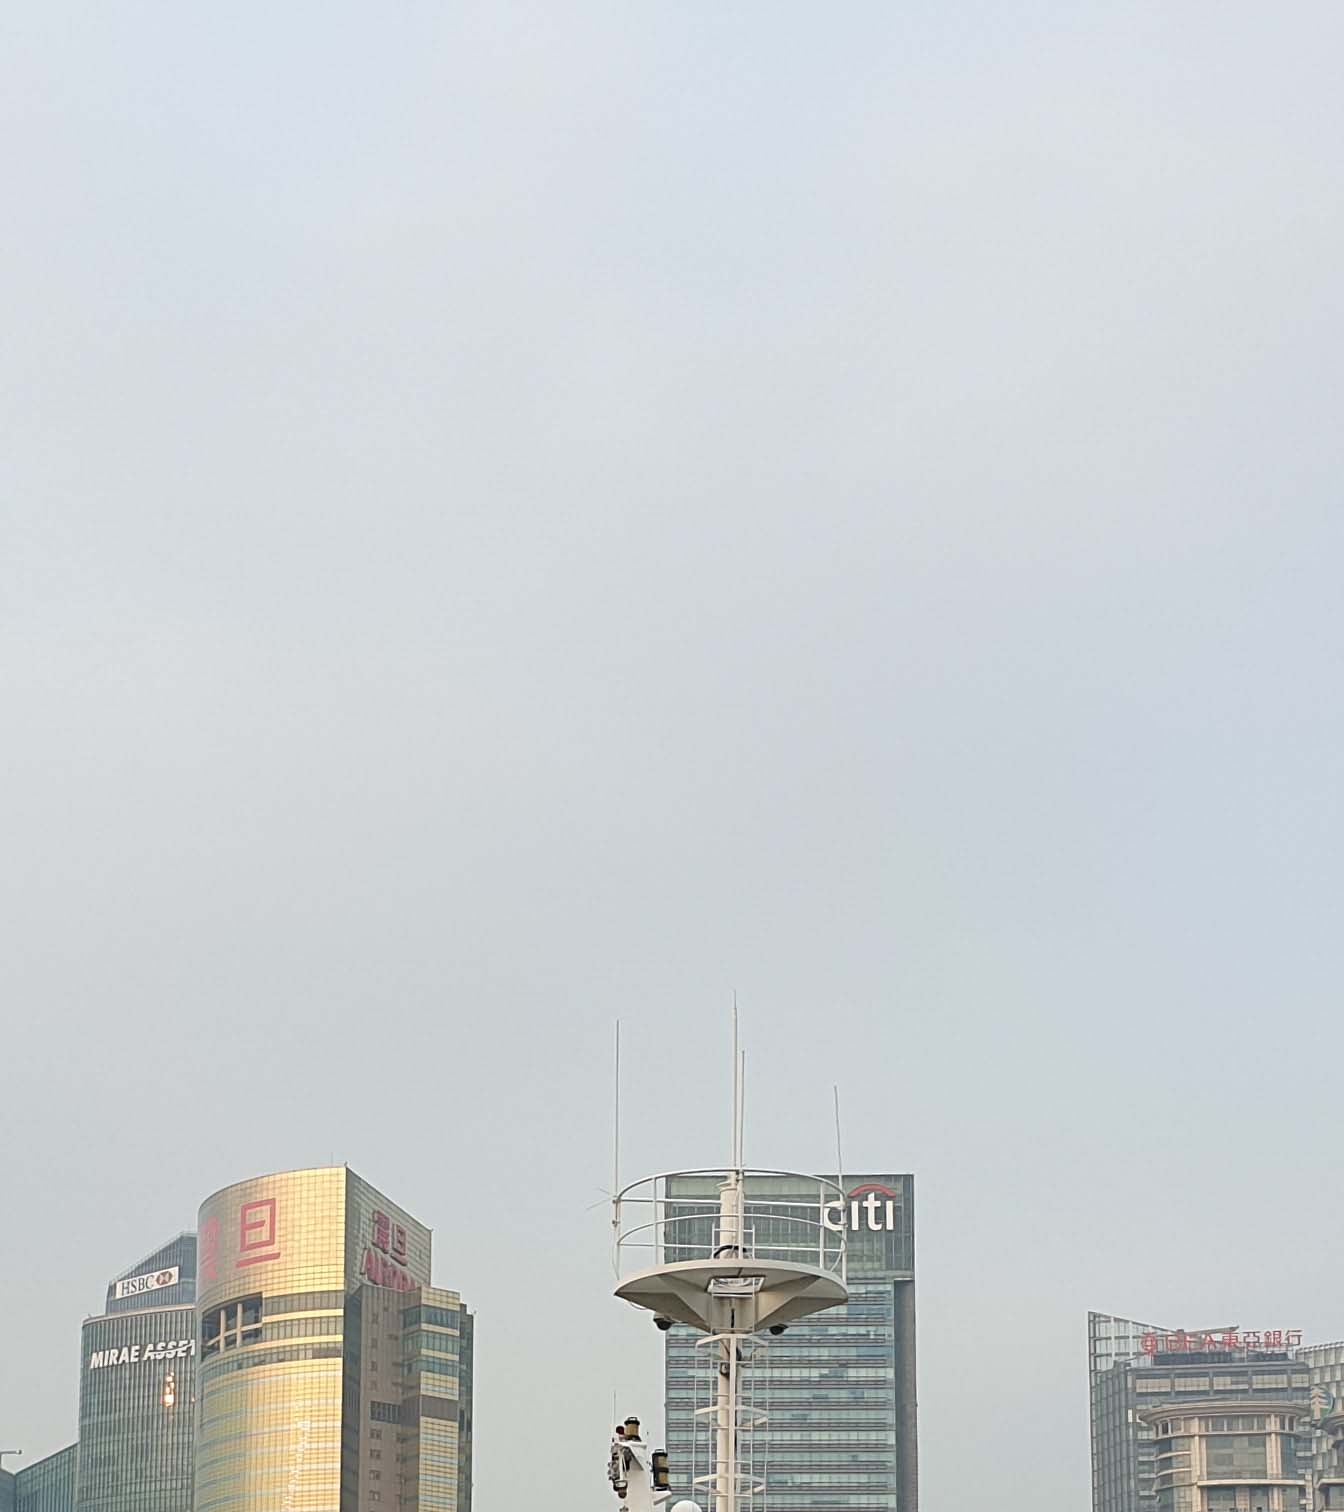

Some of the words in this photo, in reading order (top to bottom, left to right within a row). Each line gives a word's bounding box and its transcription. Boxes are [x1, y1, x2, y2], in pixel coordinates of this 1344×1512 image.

[823, 1191, 894, 1231] citi
[121, 1274, 155, 1296] HSBC
[1222, 1330, 1303, 1349] 東亞銀行
[90, 1345, 140, 1369] MIRAE
